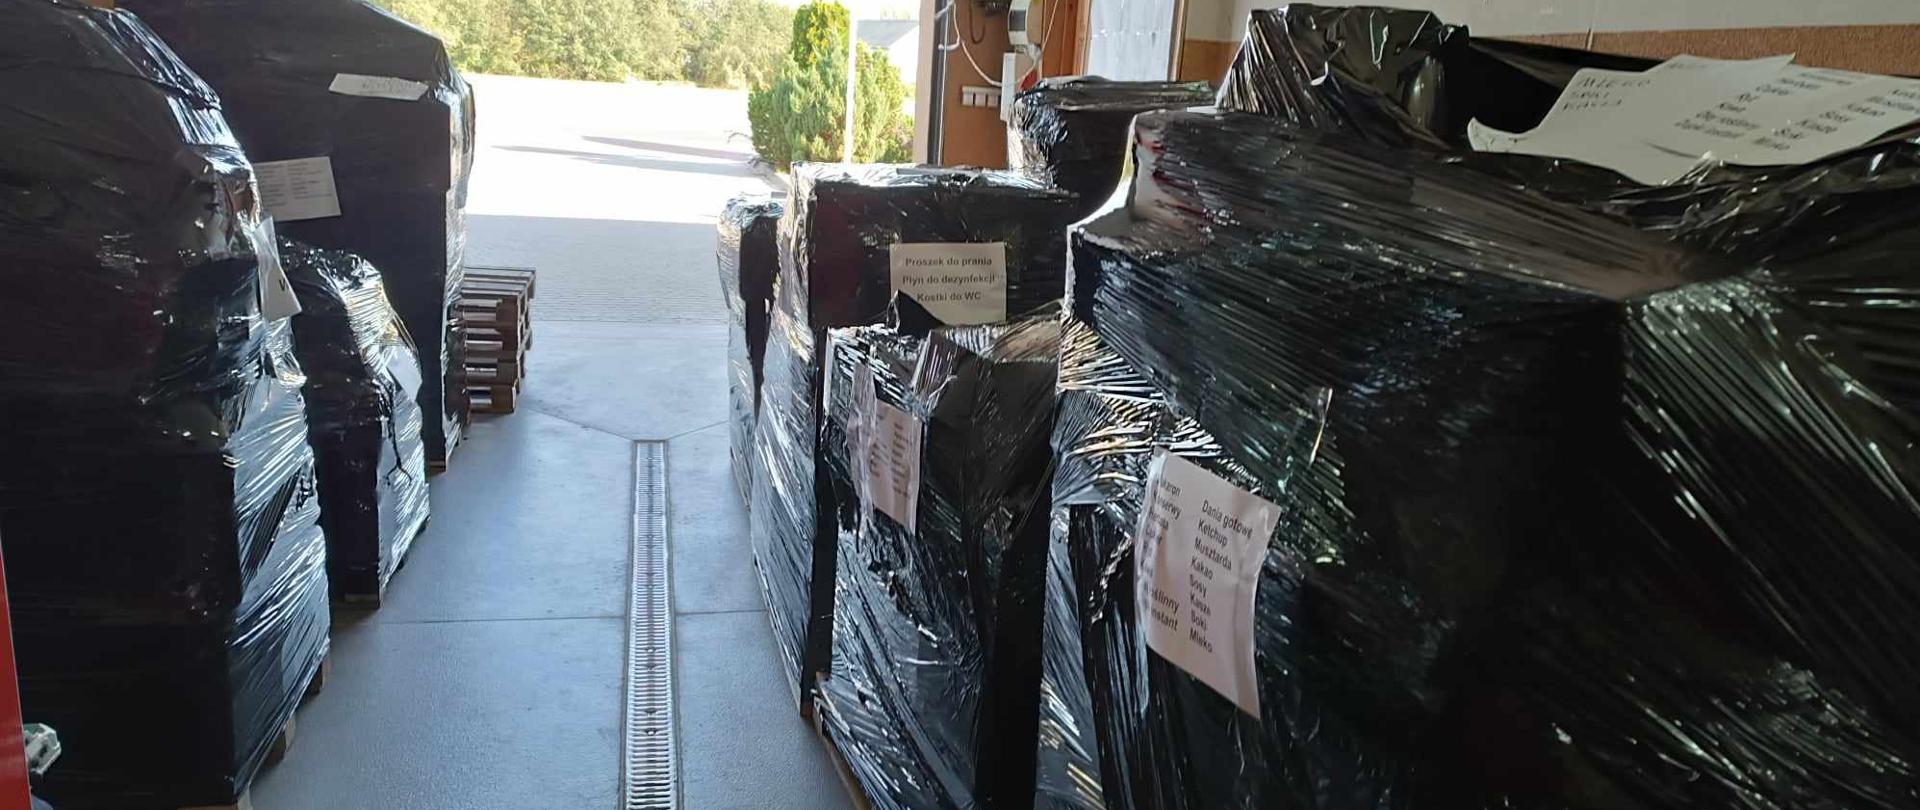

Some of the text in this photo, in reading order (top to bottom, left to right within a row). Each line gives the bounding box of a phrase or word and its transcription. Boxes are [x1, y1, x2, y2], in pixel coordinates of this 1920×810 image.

[905, 257, 992, 268] Proszek do prania
[927, 275, 939, 284] do
[941, 274, 996, 285] dezynfekcji
[917, 291, 983, 302] Kostki do WC
[1202, 499, 1223, 522] Dania
[1198, 519, 1228, 549] Ketchup
[1194, 536, 1232, 572] Musztarda
[1191, 555, 1214, 581] Kakao
[1189, 574, 1207, 598] Sosy
[1190, 609, 1207, 632] Soki
[1189, 627, 1213, 654] Mleko
